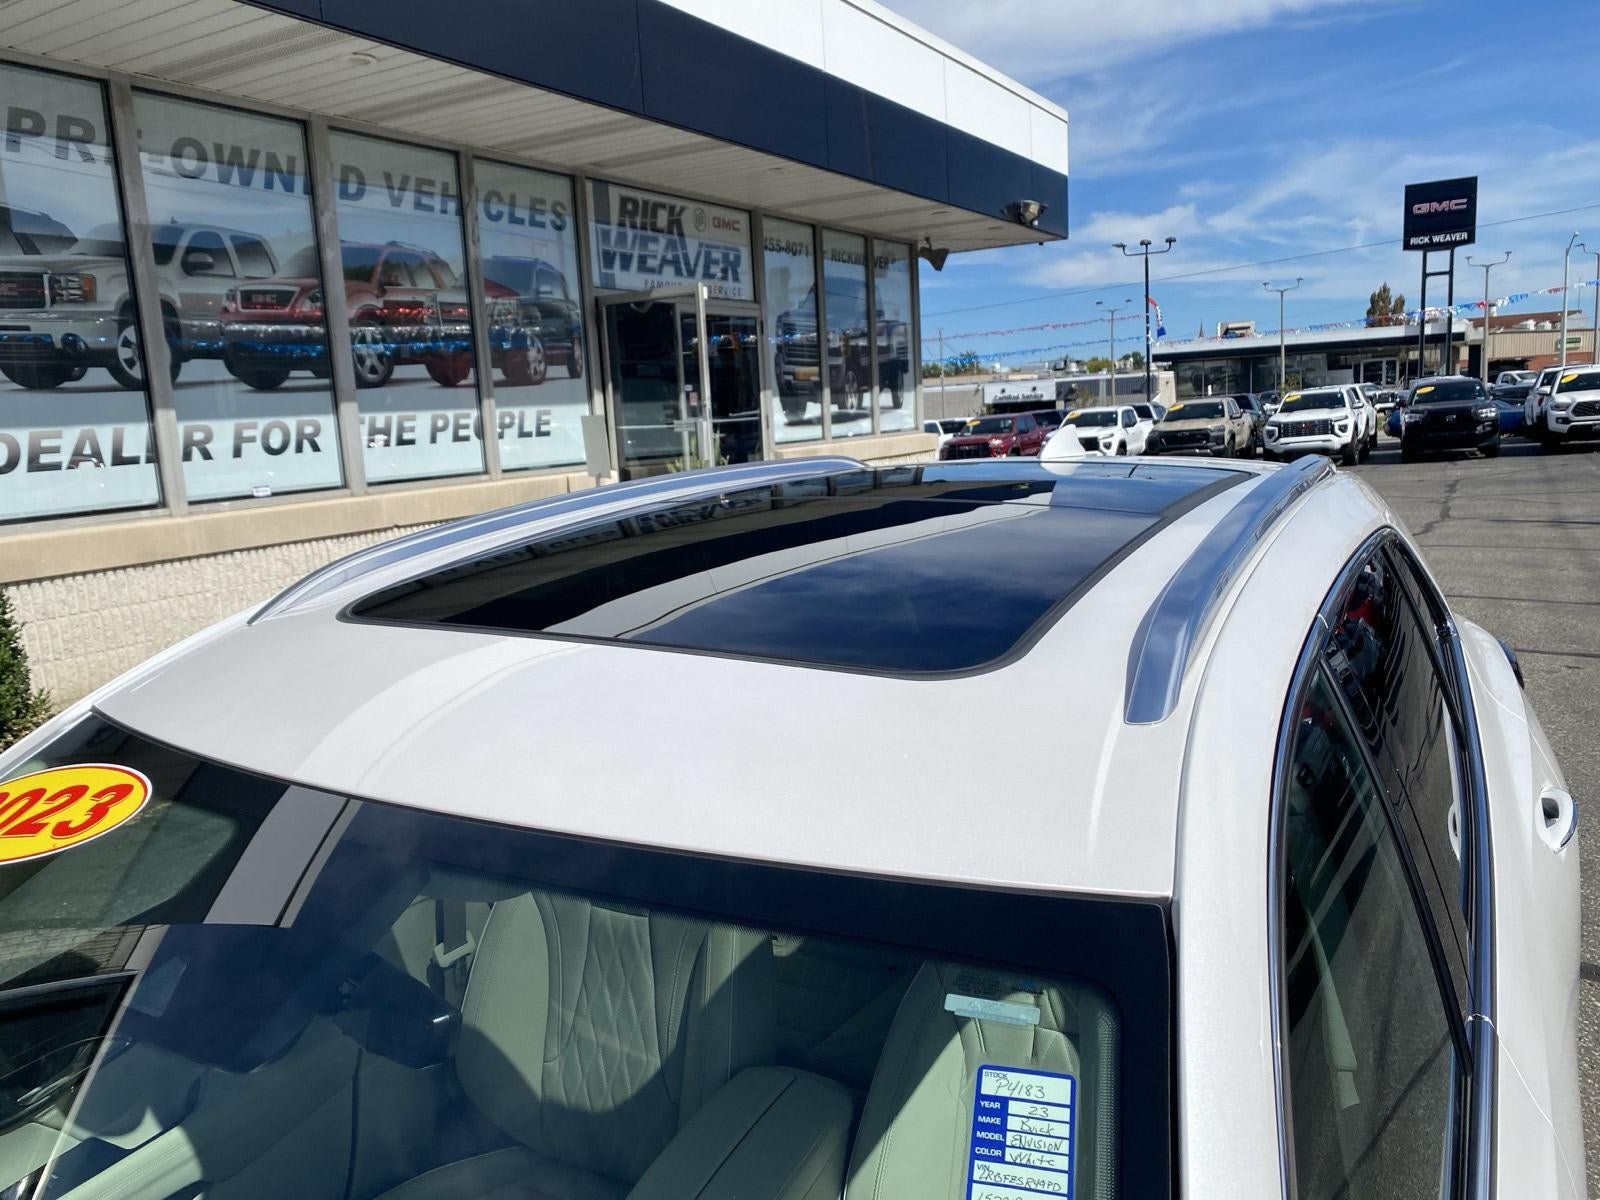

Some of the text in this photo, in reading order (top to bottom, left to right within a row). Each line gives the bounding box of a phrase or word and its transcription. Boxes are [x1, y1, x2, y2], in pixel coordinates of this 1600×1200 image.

[1412, 198, 1468, 215] GMC
[616, 194, 687, 236] RICK
[712, 216, 741, 232] GMC
[1410, 231, 1468, 246] RICK WEAVER
[599, 224, 742, 283] WEAVER
[232, 418, 321, 458] FOR
[358, 413, 417, 449] HE
[984, 1071, 1008, 1080] STOCK
[994, 1078, 1046, 1099] P4183
[980, 1100, 1001, 1110] YEAR
[1028, 1105, 1049, 1118] 23
[977, 1115, 1002, 1125] MAKE
[976, 1130, 1005, 1142] MODEL
[975, 1146, 1002, 1158] COLOR
[976, 1163, 991, 1173] VIN
